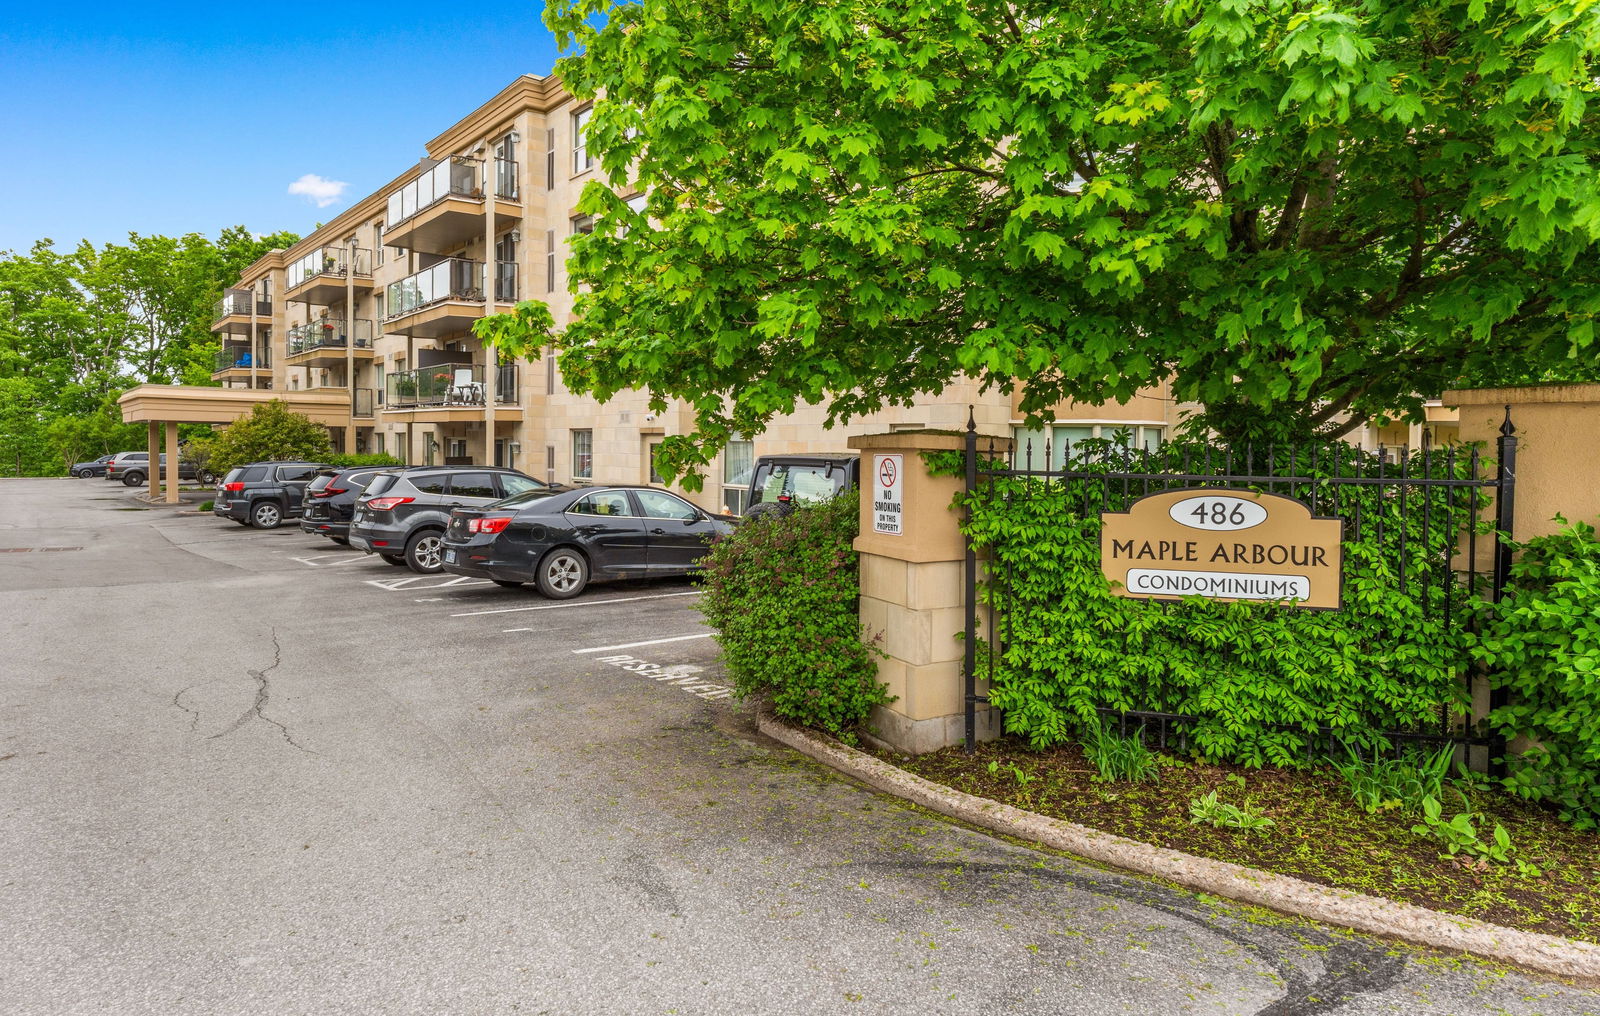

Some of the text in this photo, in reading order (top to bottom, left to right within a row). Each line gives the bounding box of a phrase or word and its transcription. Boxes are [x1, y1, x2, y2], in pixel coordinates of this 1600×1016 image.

[884, 490, 891, 500] NO
[875, 501, 900, 513] SMOKING
[1190, 502, 1245, 526] 486
[877, 522, 898, 532] PROPERTY
[1112, 539, 1329, 567] MAPLE ARBOUR
[1137, 574, 1298, 596] CONDOMINIUMS
